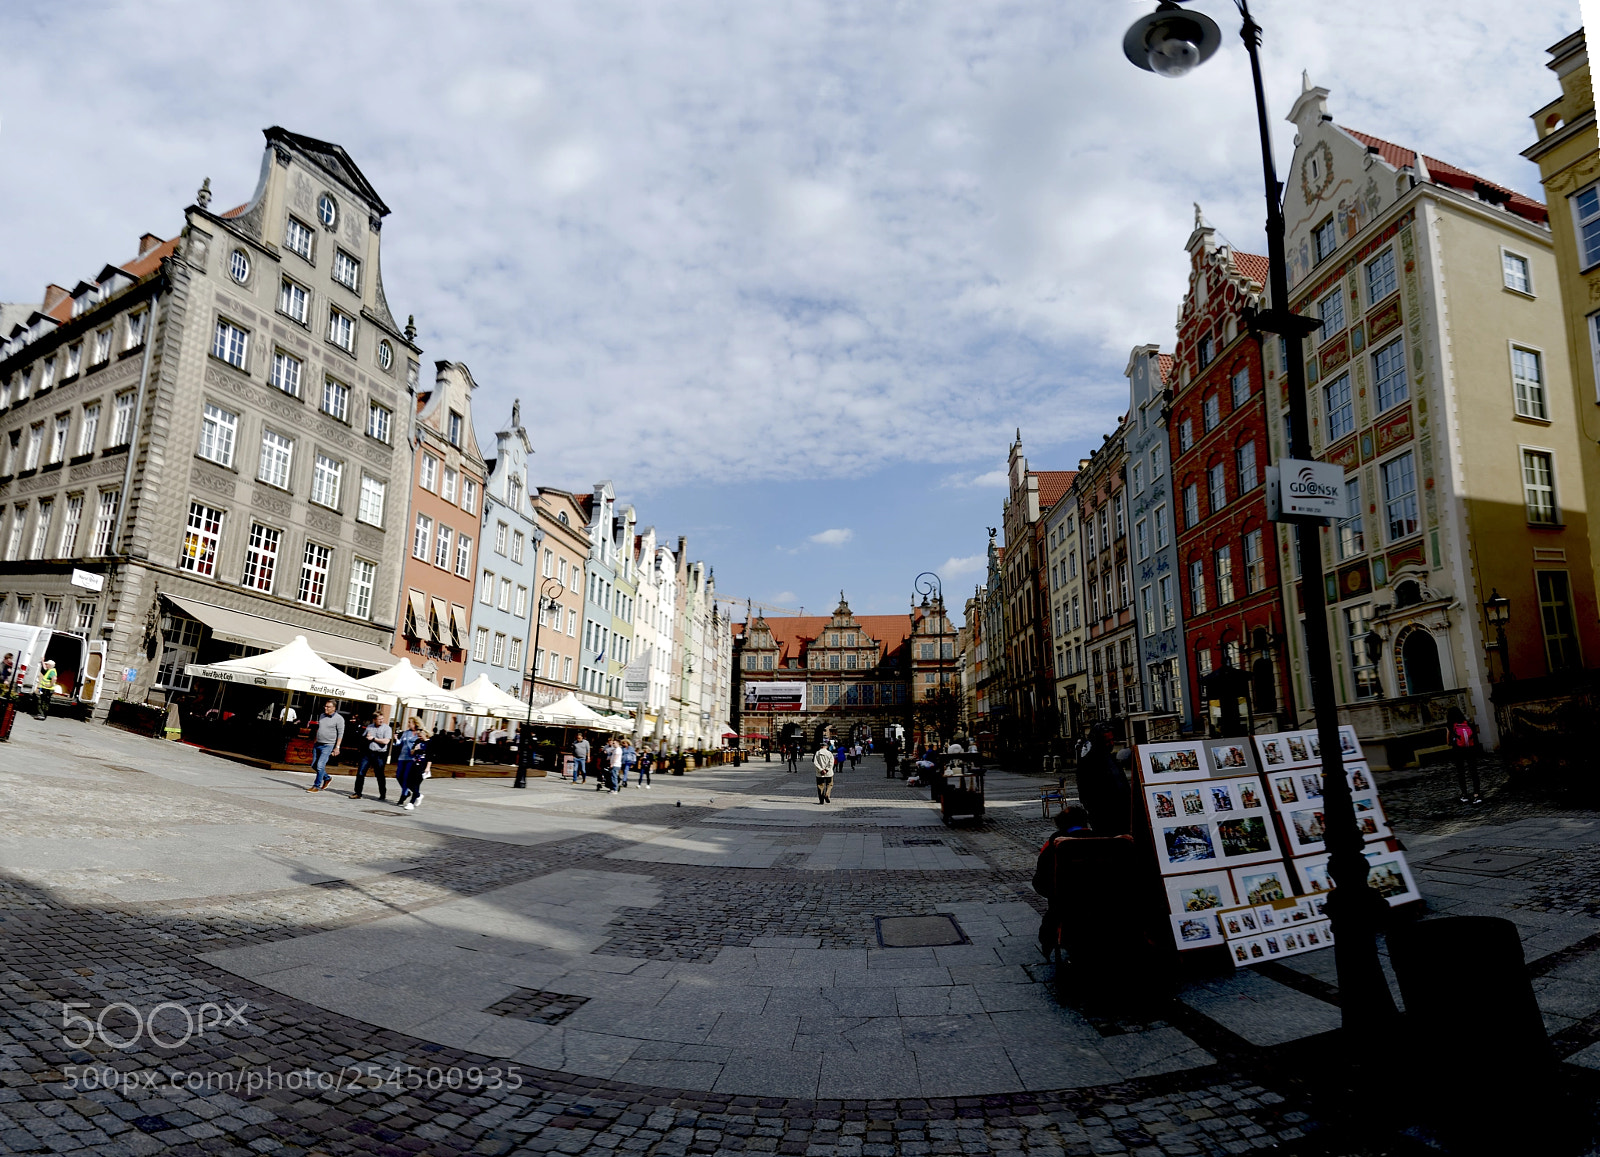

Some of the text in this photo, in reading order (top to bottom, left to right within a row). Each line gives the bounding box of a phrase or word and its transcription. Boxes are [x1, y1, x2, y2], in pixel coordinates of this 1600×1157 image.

[1290, 482, 1338, 496] GD@ŃSK
[201, 669, 213, 678] Hard
[212, 671, 224, 680] Rock
[310, 684, 346, 697] Hard Rock Cafe
